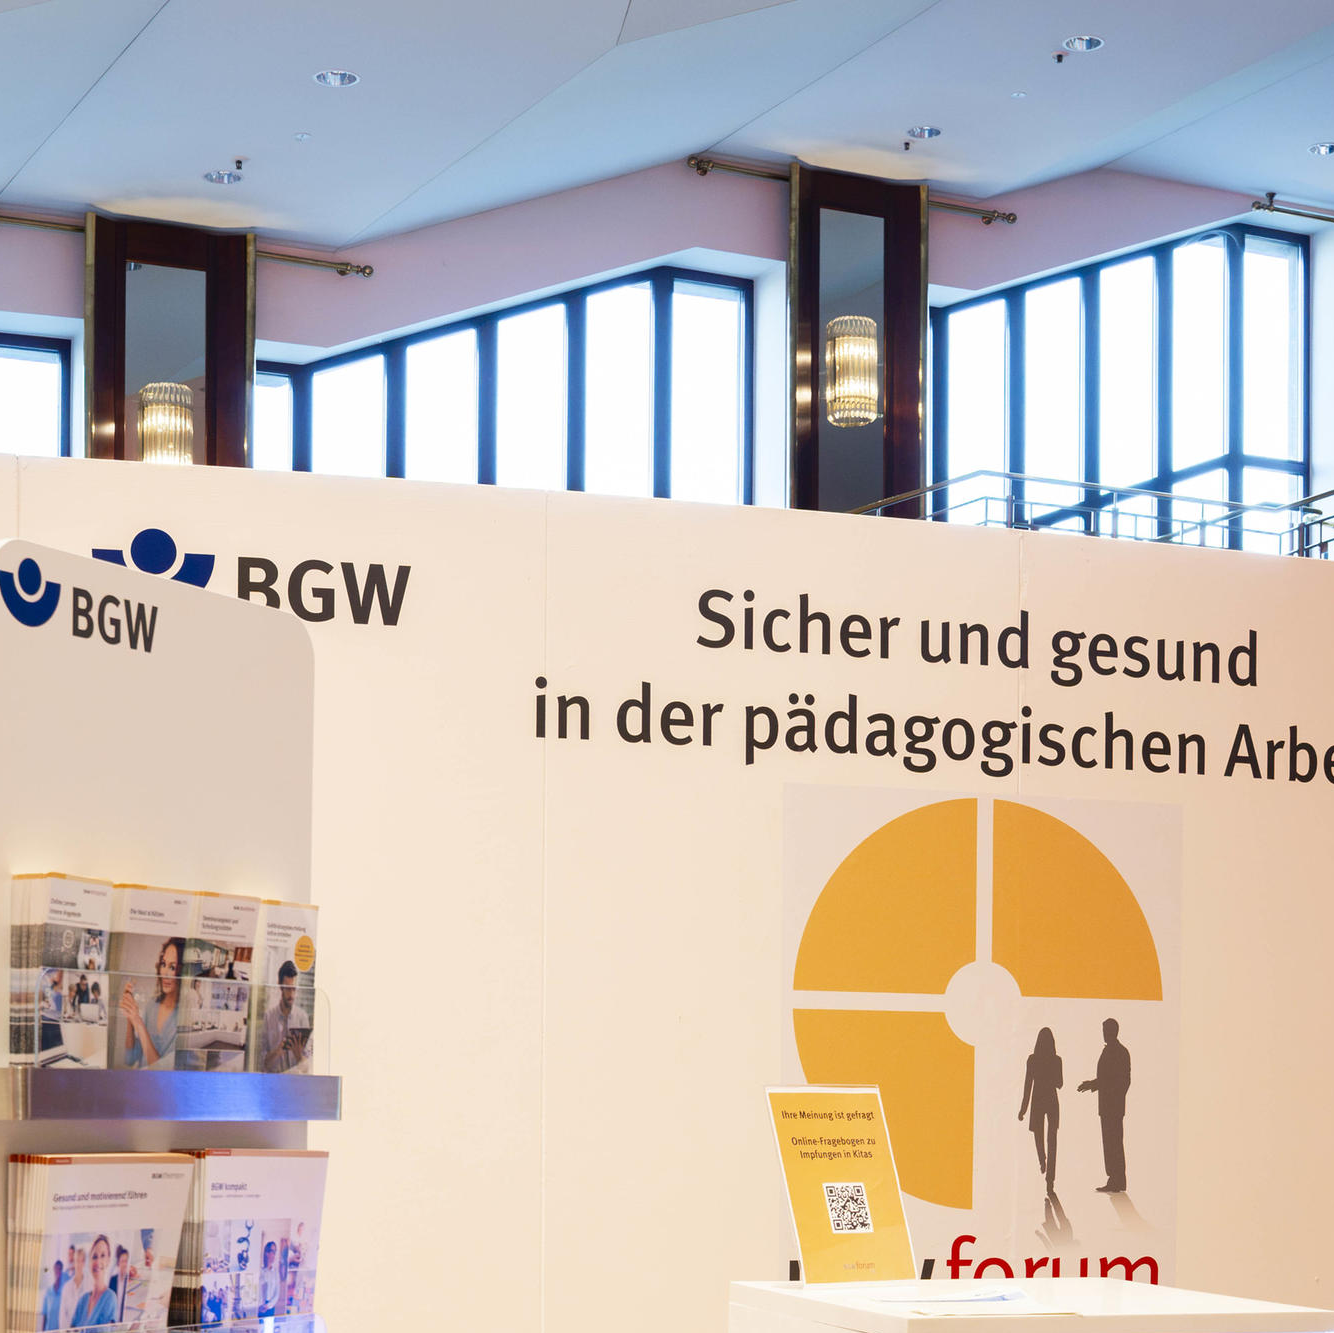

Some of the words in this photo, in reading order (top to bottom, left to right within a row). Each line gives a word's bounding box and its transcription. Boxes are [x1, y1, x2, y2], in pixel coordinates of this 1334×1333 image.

[72, 586, 158, 653] BGW
[237, 556, 411, 626] BGW
[696, 588, 901, 661] Sicher
[920, 610, 1030, 669] und
[1051, 629, 1259, 688] gesund
[533, 677, 590, 741] in
[616, 682, 723, 747] der
[745, 690, 1207, 777] pädagogischen
[782, 1110, 797, 1120] Ihre
[799, 1110, 833, 1122] Meinung
[835, 1110, 845, 1120] ist
[846, 1110, 874, 1122] gefragt
[791, 1136, 864, 1148] Online-Fragebogen
[866, 1138, 876, 1146] zu
[800, 1149, 841, 1161] Impfungen
[843, 1150, 851, 1159] in
[853, 1149, 873, 1159] Kitas
